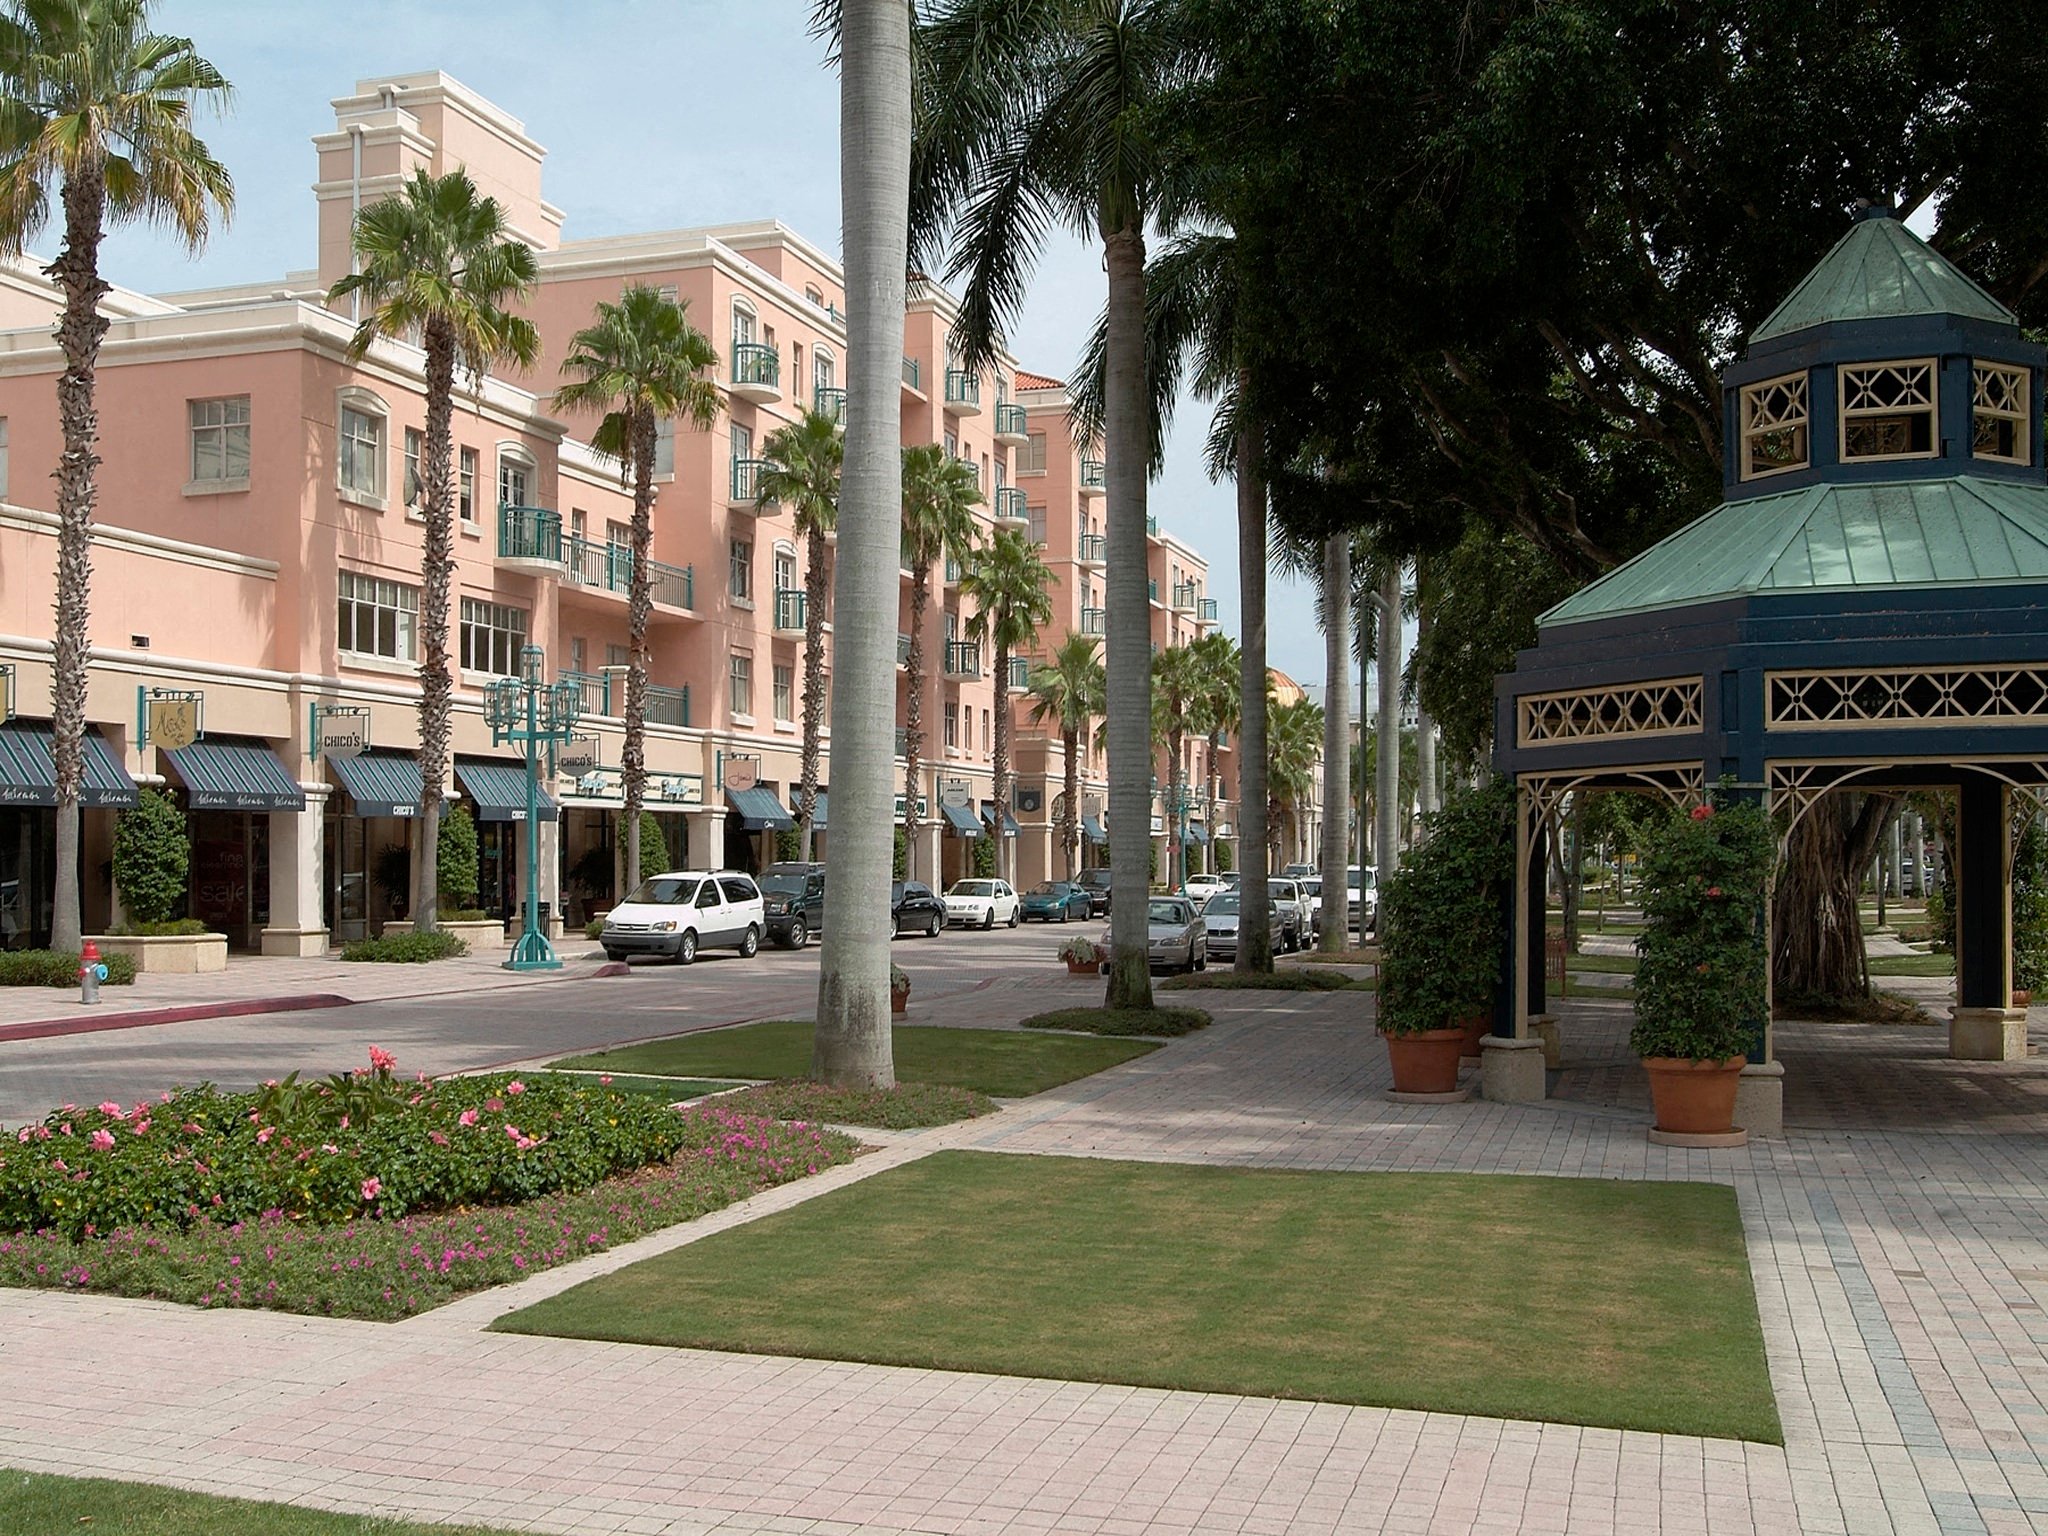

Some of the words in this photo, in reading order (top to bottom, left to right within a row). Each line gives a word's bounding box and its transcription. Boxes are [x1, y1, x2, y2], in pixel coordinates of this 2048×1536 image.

[324, 731, 361, 747] CHICO'S
[561, 753, 592, 767] CHICO'S
[392, 805, 415, 816] CHICO'S
[199, 881, 245, 902] sale
